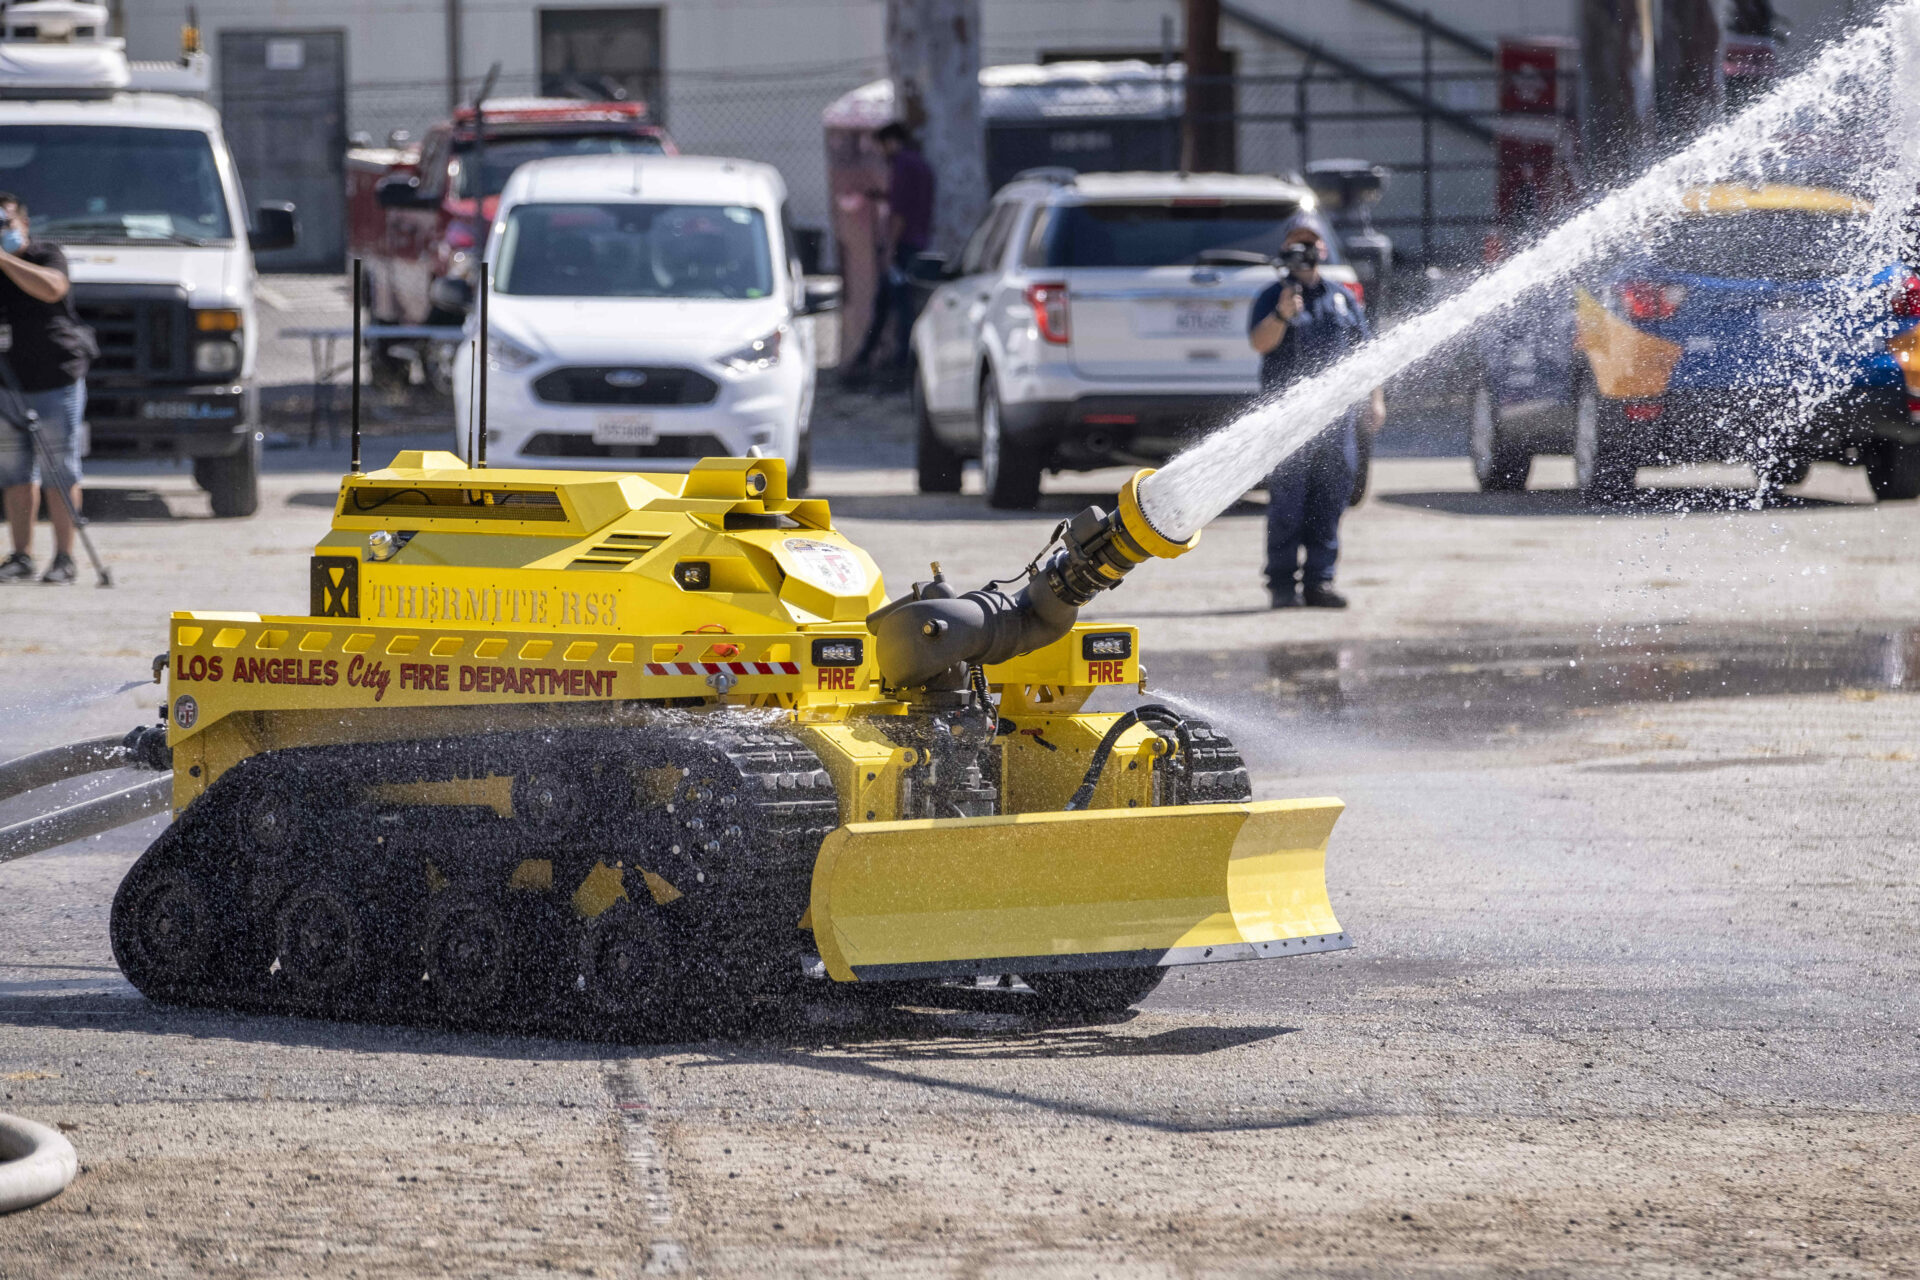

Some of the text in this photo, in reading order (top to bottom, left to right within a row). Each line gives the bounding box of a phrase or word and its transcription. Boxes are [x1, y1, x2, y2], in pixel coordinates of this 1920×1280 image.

[373, 585, 617, 626] THERMITE RS3
[177, 654, 618, 702] LOS ANGELES City FIRE DEPARTMENT
[818, 668, 856, 690] FIRE
[1088, 660, 1124, 684] FIRE
